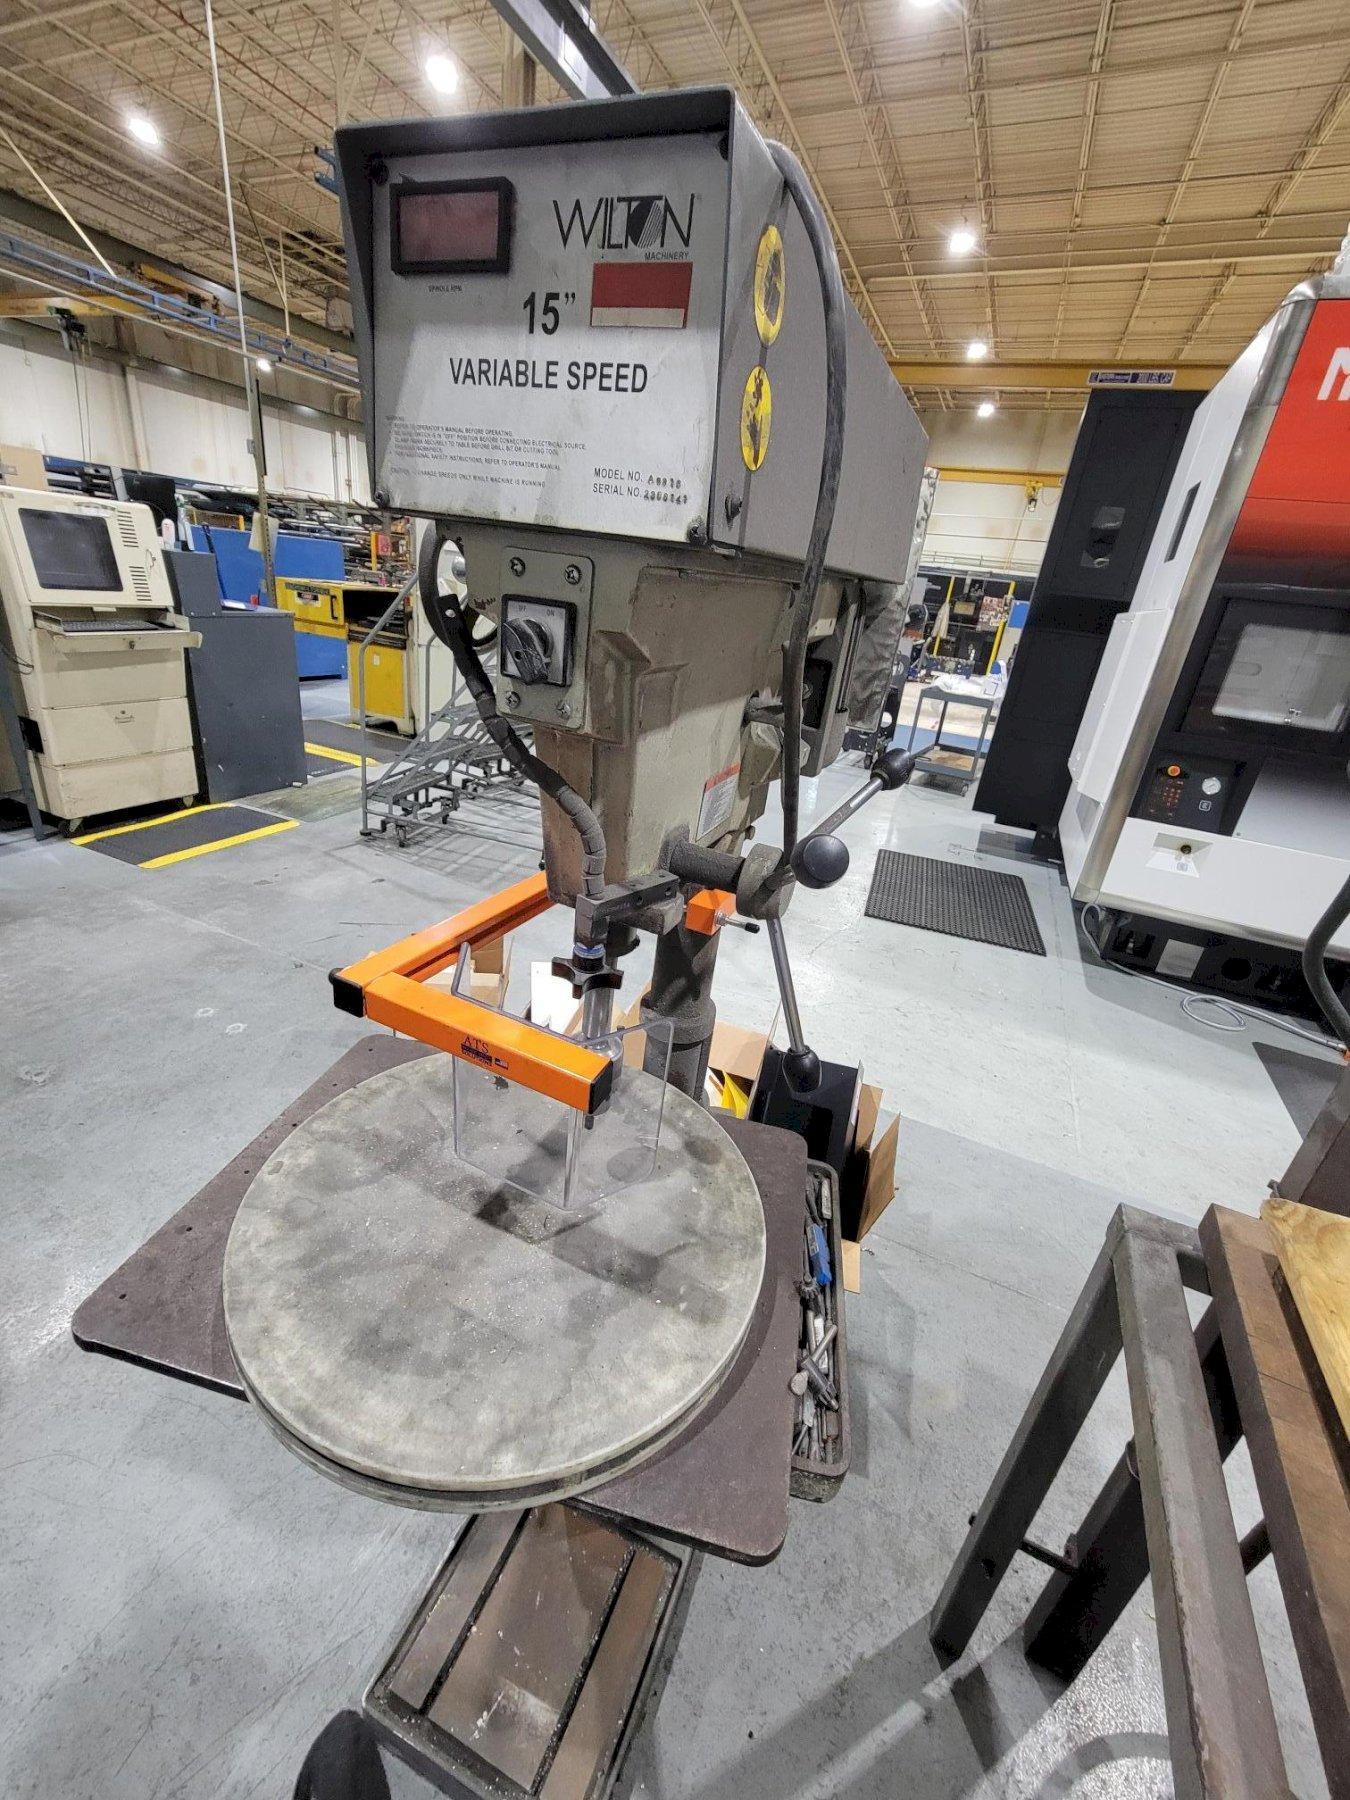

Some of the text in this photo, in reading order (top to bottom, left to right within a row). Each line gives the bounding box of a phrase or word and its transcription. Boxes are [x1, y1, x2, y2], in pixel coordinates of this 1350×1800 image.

[552, 192, 696, 250] WILTON
[644, 252, 689, 260] MACHINERY
[449, 357, 648, 393] VARIABLE SPEED
[593, 467, 625, 480] MODEL
[592, 482, 625, 496] SERIAL
[546, 609, 555, 617] ON
[464, 1035, 489, 1054] ATS
